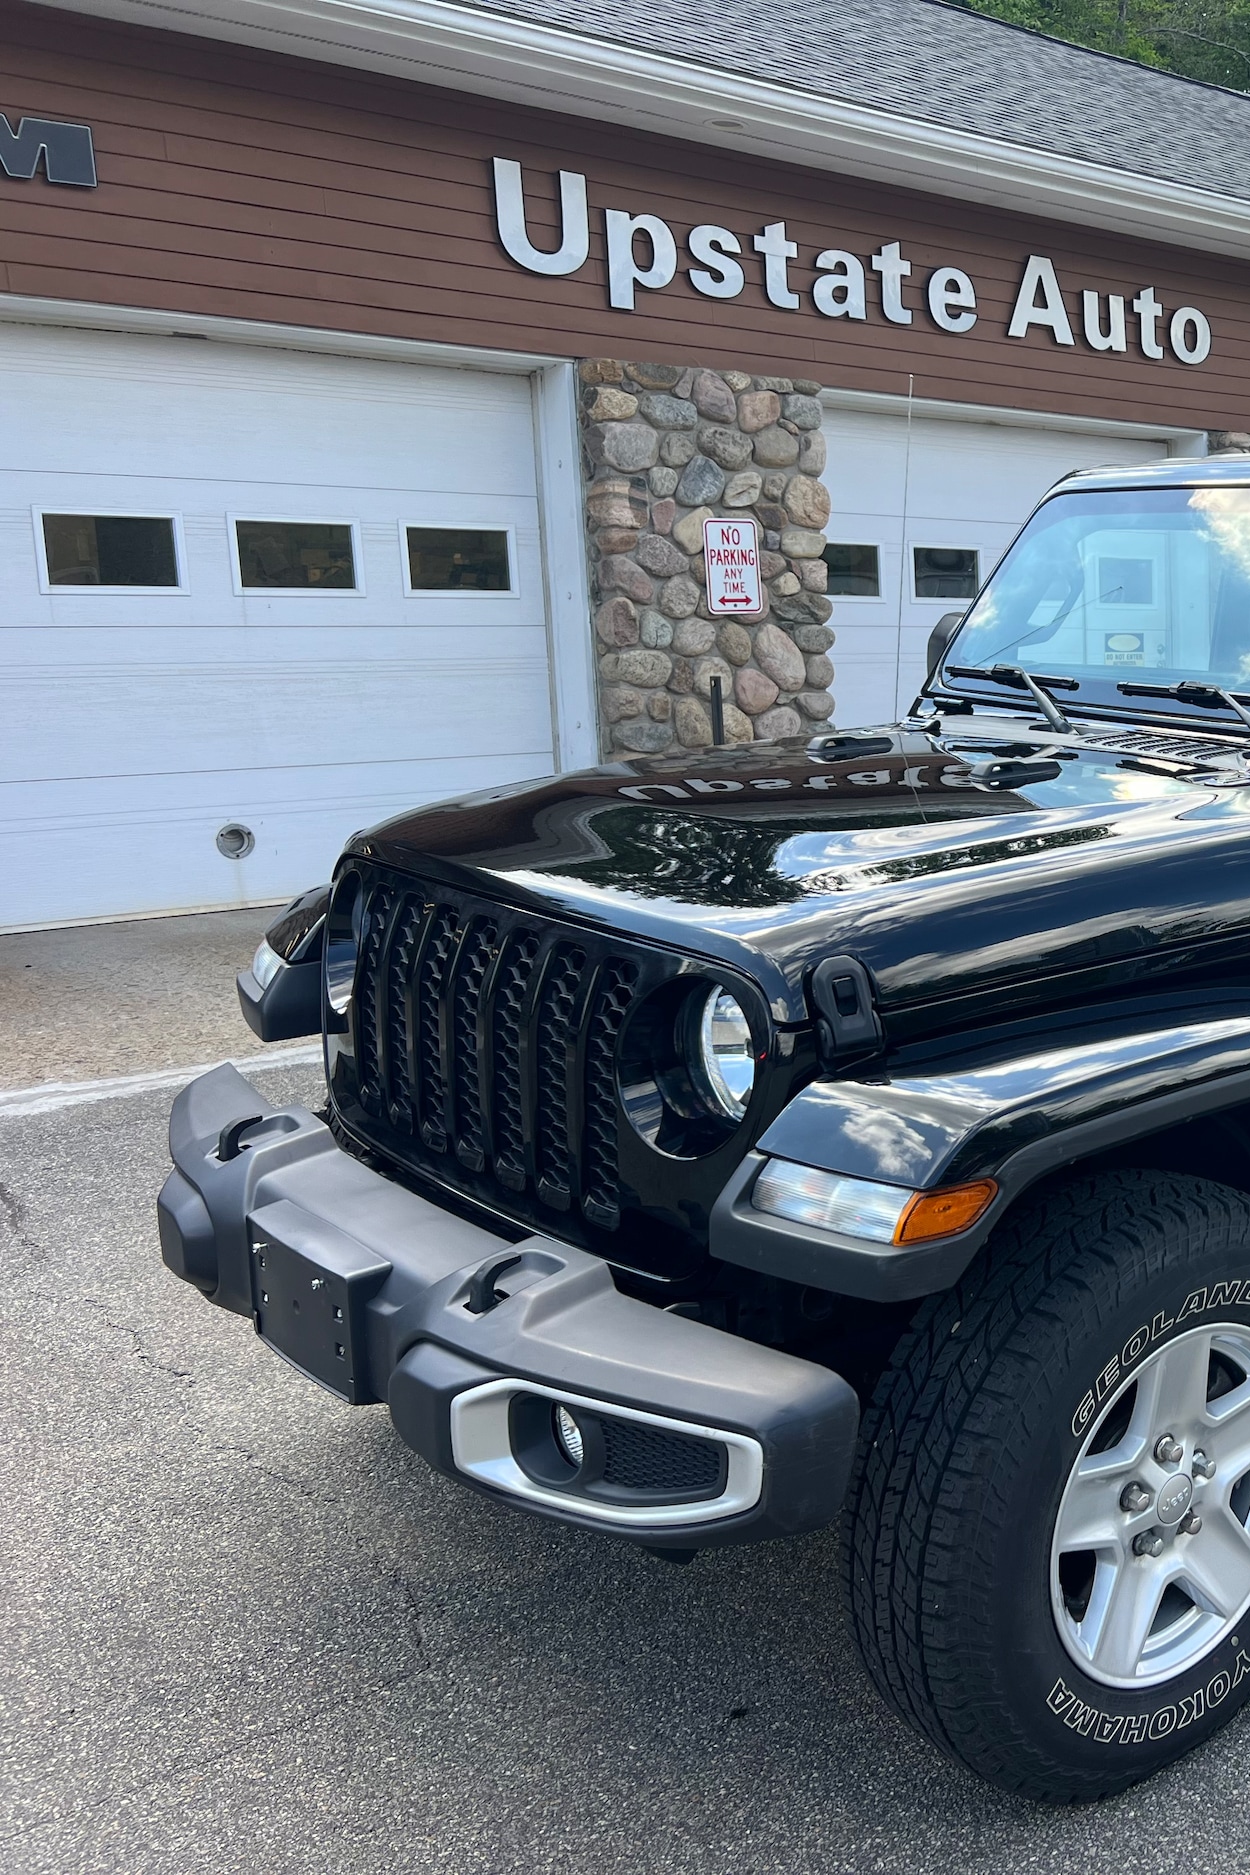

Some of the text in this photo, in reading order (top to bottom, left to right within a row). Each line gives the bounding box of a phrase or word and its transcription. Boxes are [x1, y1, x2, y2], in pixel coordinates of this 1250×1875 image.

[492, 156, 1212, 366] Upstate Auto
[721, 528, 741, 545] NO
[710, 549, 755, 566] PARKING
[724, 568, 743, 580] ANY
[723, 581, 746, 594] TIME
[1106, 653, 1144, 661] DO NOT ENTER
[1162, 1486, 1189, 1512] Jeep
